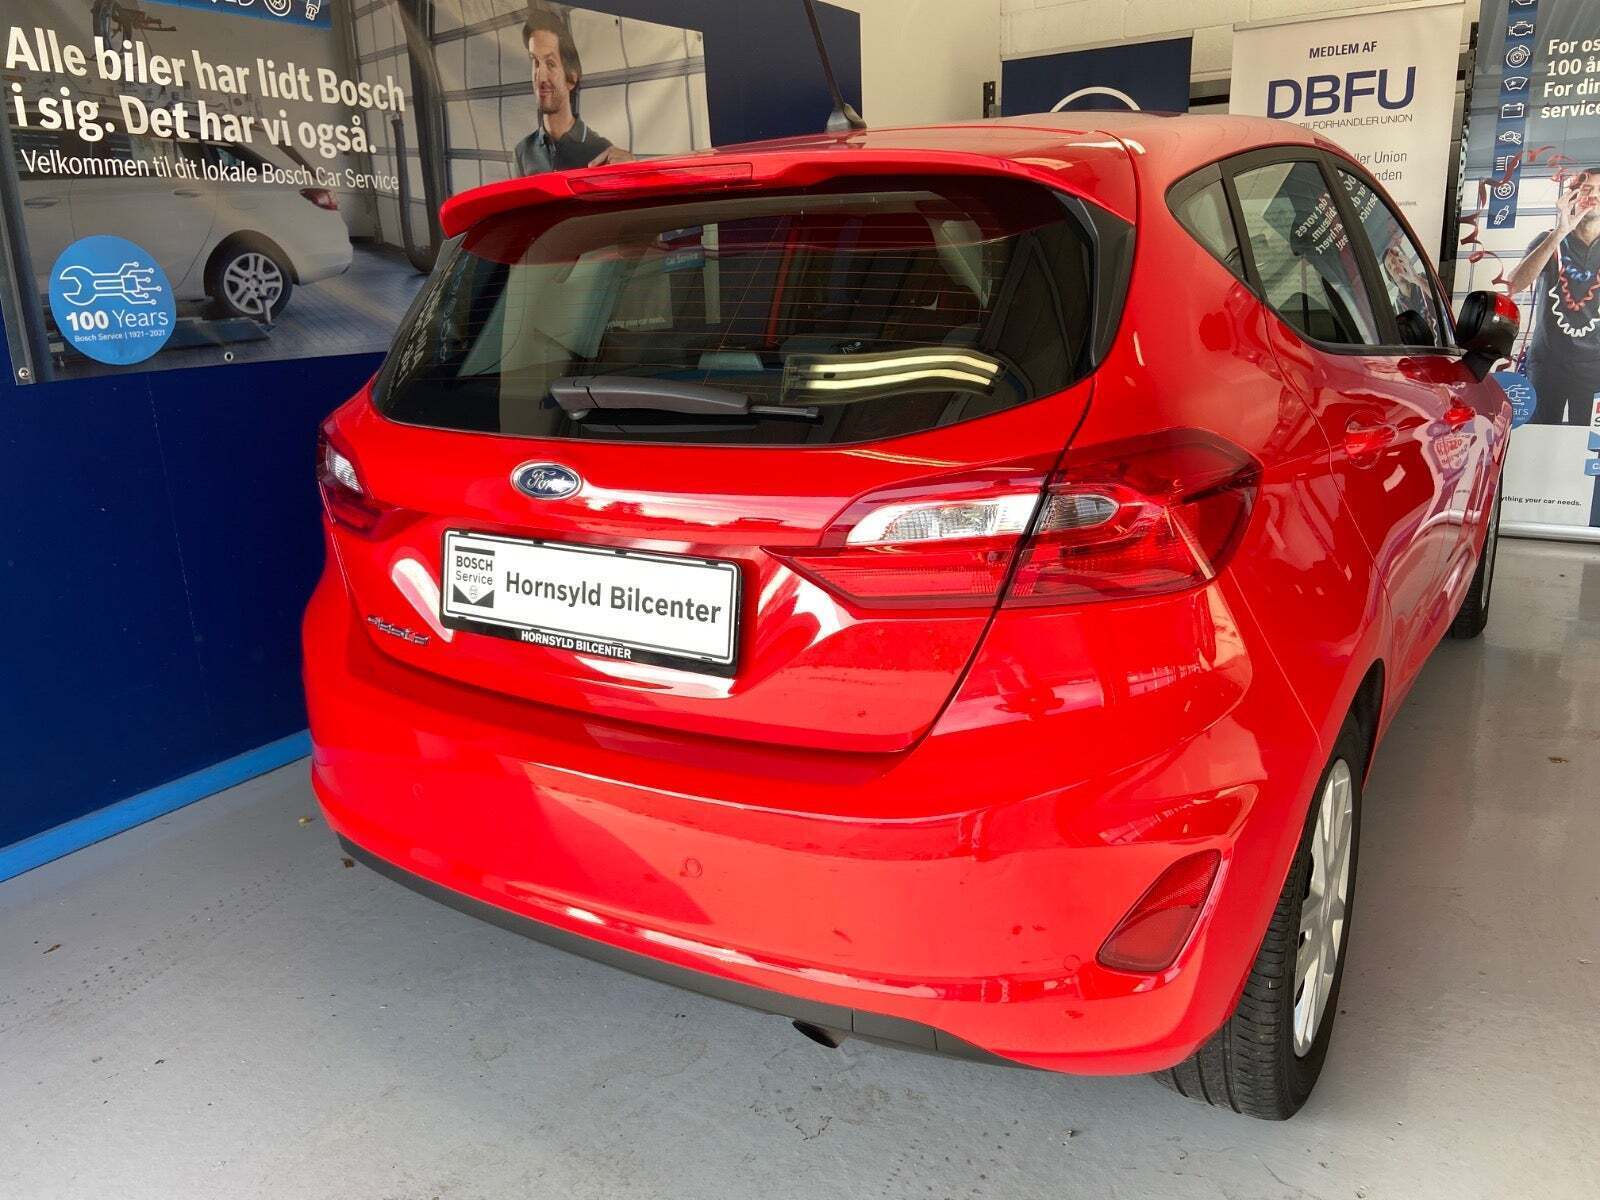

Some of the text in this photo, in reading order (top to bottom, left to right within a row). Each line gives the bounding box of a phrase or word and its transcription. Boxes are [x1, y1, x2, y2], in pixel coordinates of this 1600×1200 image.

[1309, 41, 1377, 58] MEDLEM AF
[1548, 39, 1578, 55] For
[6, 26, 405, 111] Alle biler har lidt Bosch
[1547, 58, 1582, 76] 100
[1266, 66, 1417, 119] DBFU
[1543, 81, 1573, 98] For
[11, 82, 377, 159] i sig. Det har vi også.
[1381, 114, 1413, 124] UNION
[1374, 150, 1407, 163] Union
[20, 149, 400, 190] Velkommen til dit lokale Bosch Car Service
[66, 309, 169, 331] 100 Years
[75, 334, 97, 343] Bosch
[97, 332, 123, 341] Service
[1525, 496, 1541, 504] your
[456, 555, 493, 571] BOSCH
[455, 570, 493, 585] Service
[505, 571, 722, 624] Hornsyld Bilcenter
[521, 630, 632, 660] HORNSYLD BILCENTER
